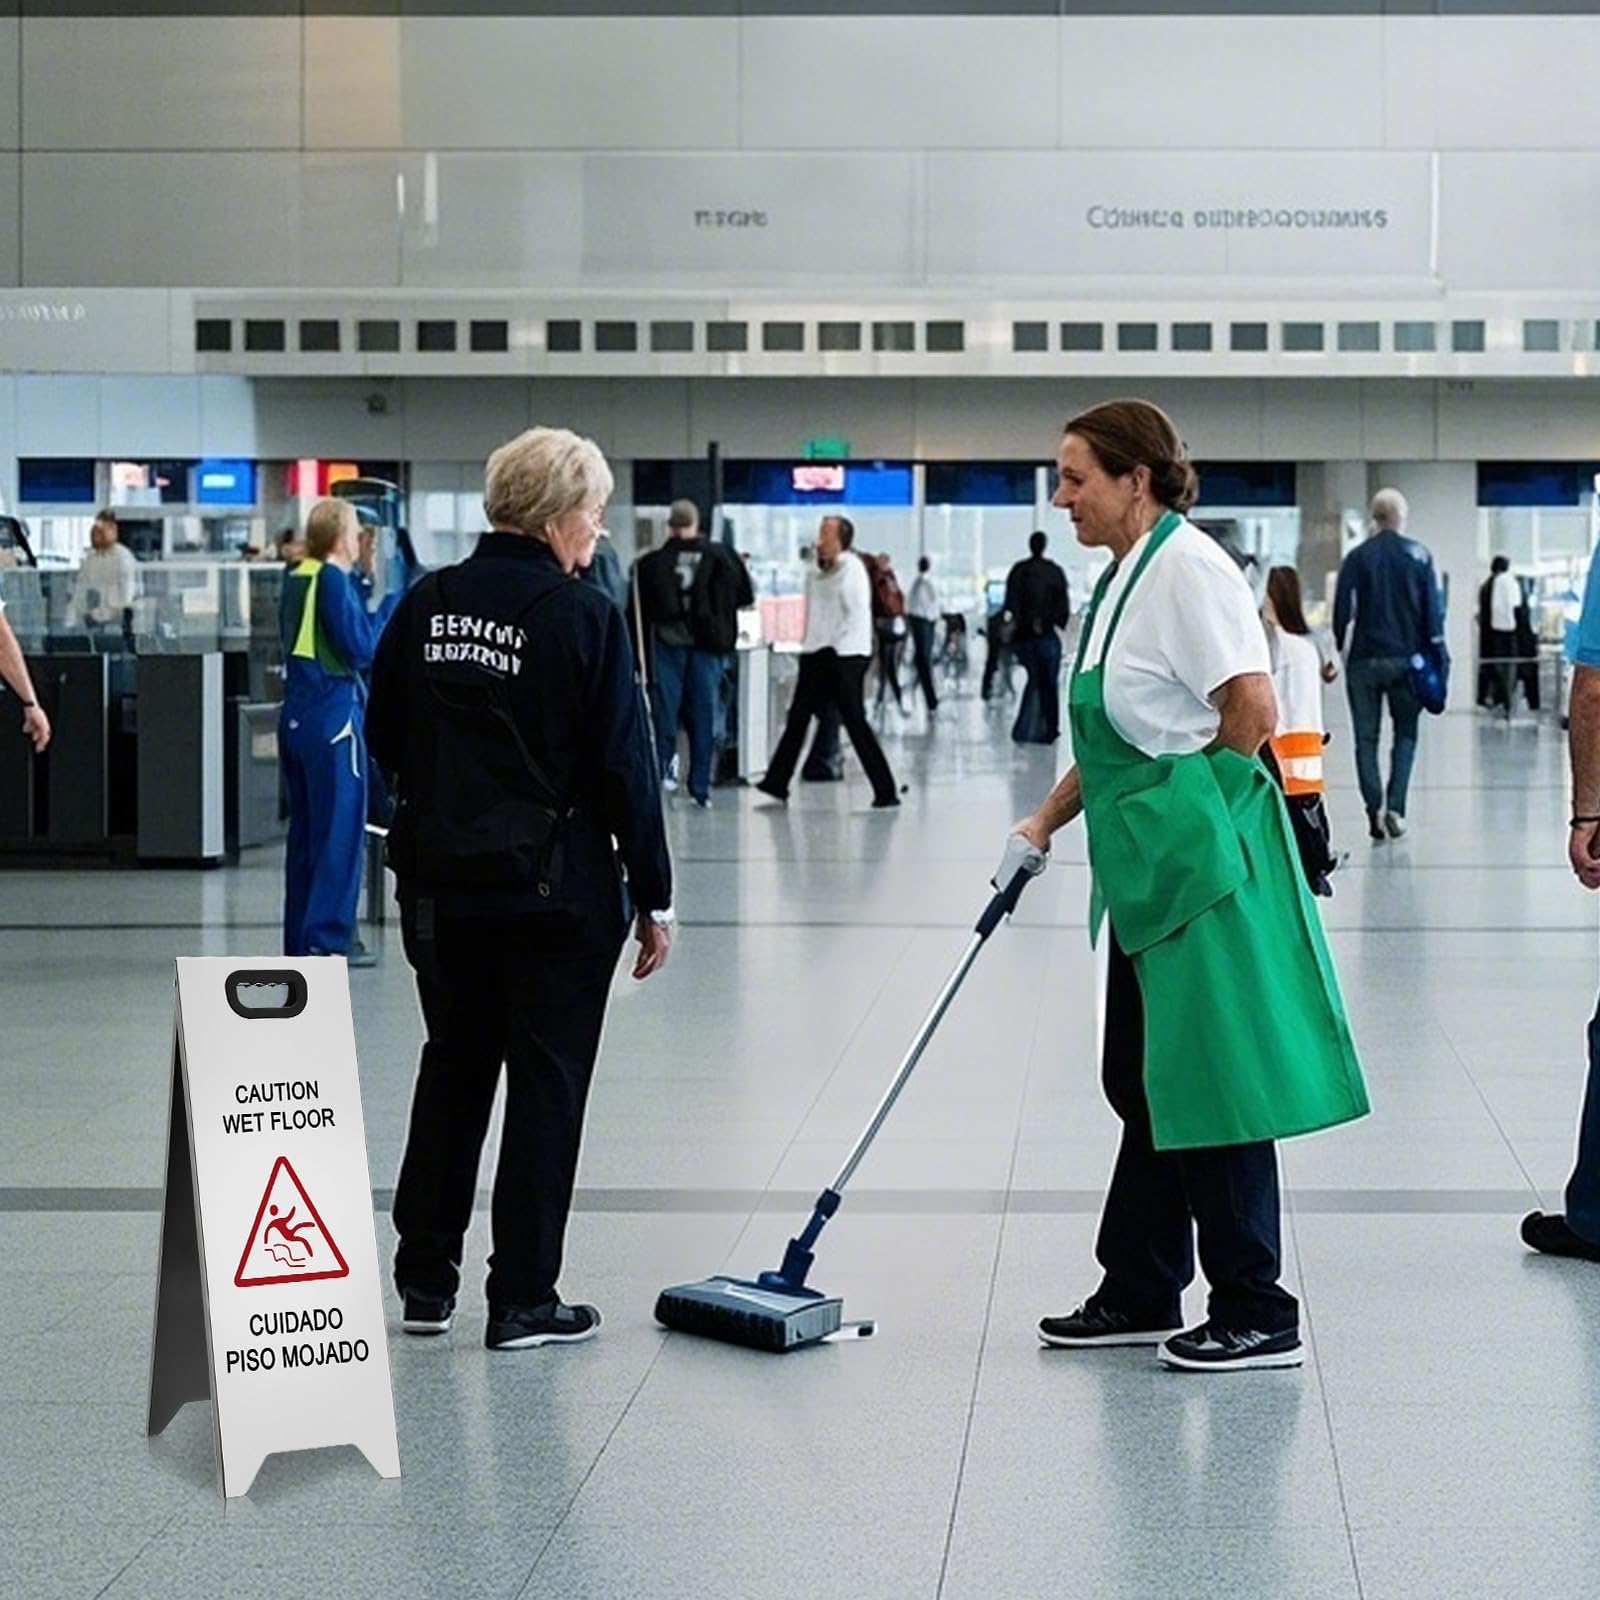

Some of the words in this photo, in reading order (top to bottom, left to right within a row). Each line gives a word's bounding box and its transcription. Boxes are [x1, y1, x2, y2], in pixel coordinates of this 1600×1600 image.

[235, 1081, 319, 1104] CAUTION
[222, 1112, 265, 1134] WET
[270, 1108, 336, 1131] FLOOR
[249, 1308, 344, 1337] CUIDADO
[226, 1347, 276, 1374] PISO
[281, 1339, 369, 1370] MOJADO
